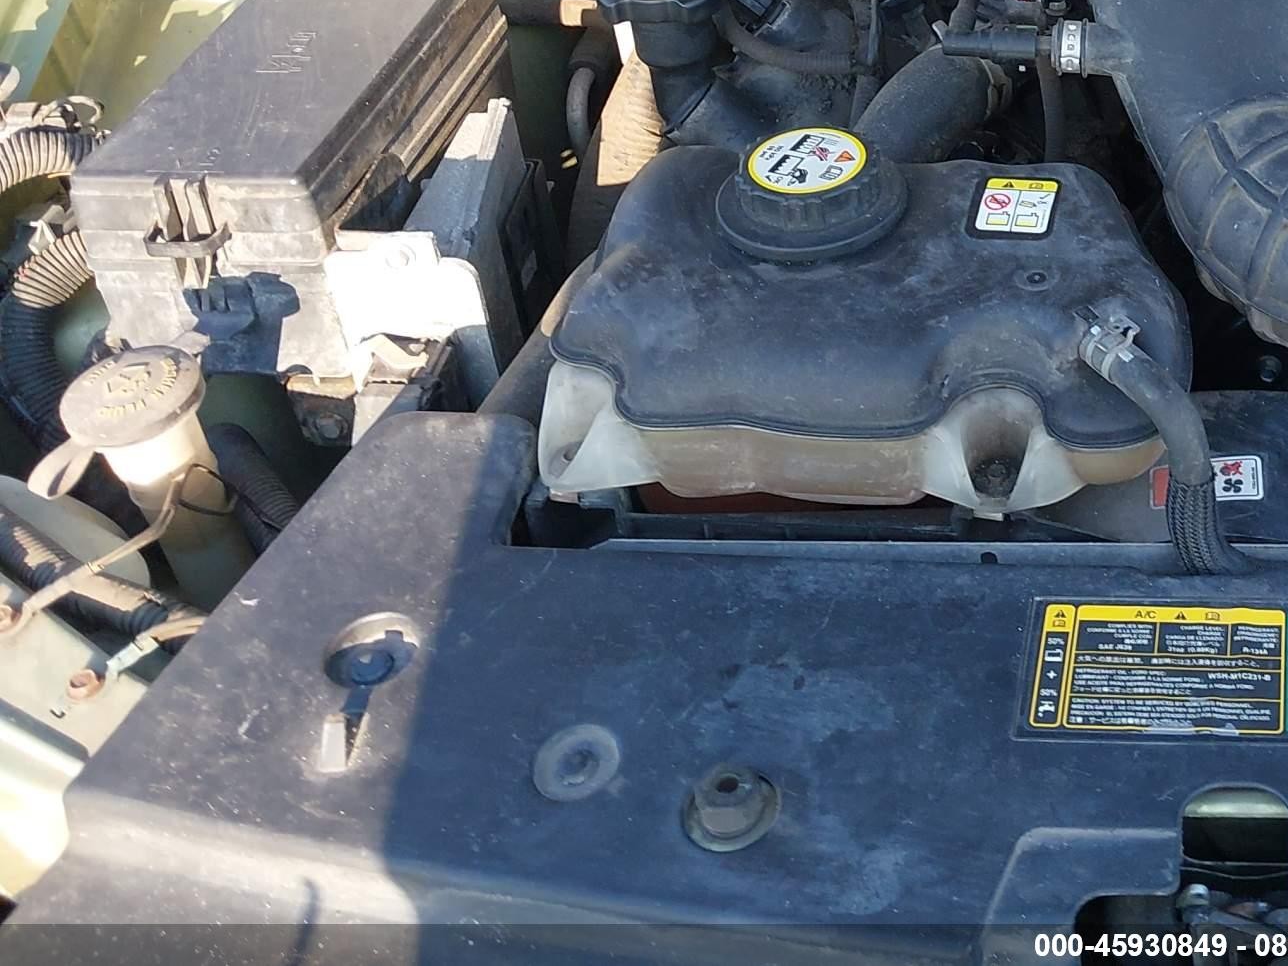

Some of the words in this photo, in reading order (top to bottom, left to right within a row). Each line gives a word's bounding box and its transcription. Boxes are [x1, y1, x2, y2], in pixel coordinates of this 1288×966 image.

[1135, 610, 1158, 620] A/C
[1047, 637, 1065, 645] 50%
[1039, 688, 1058, 696] 50%
